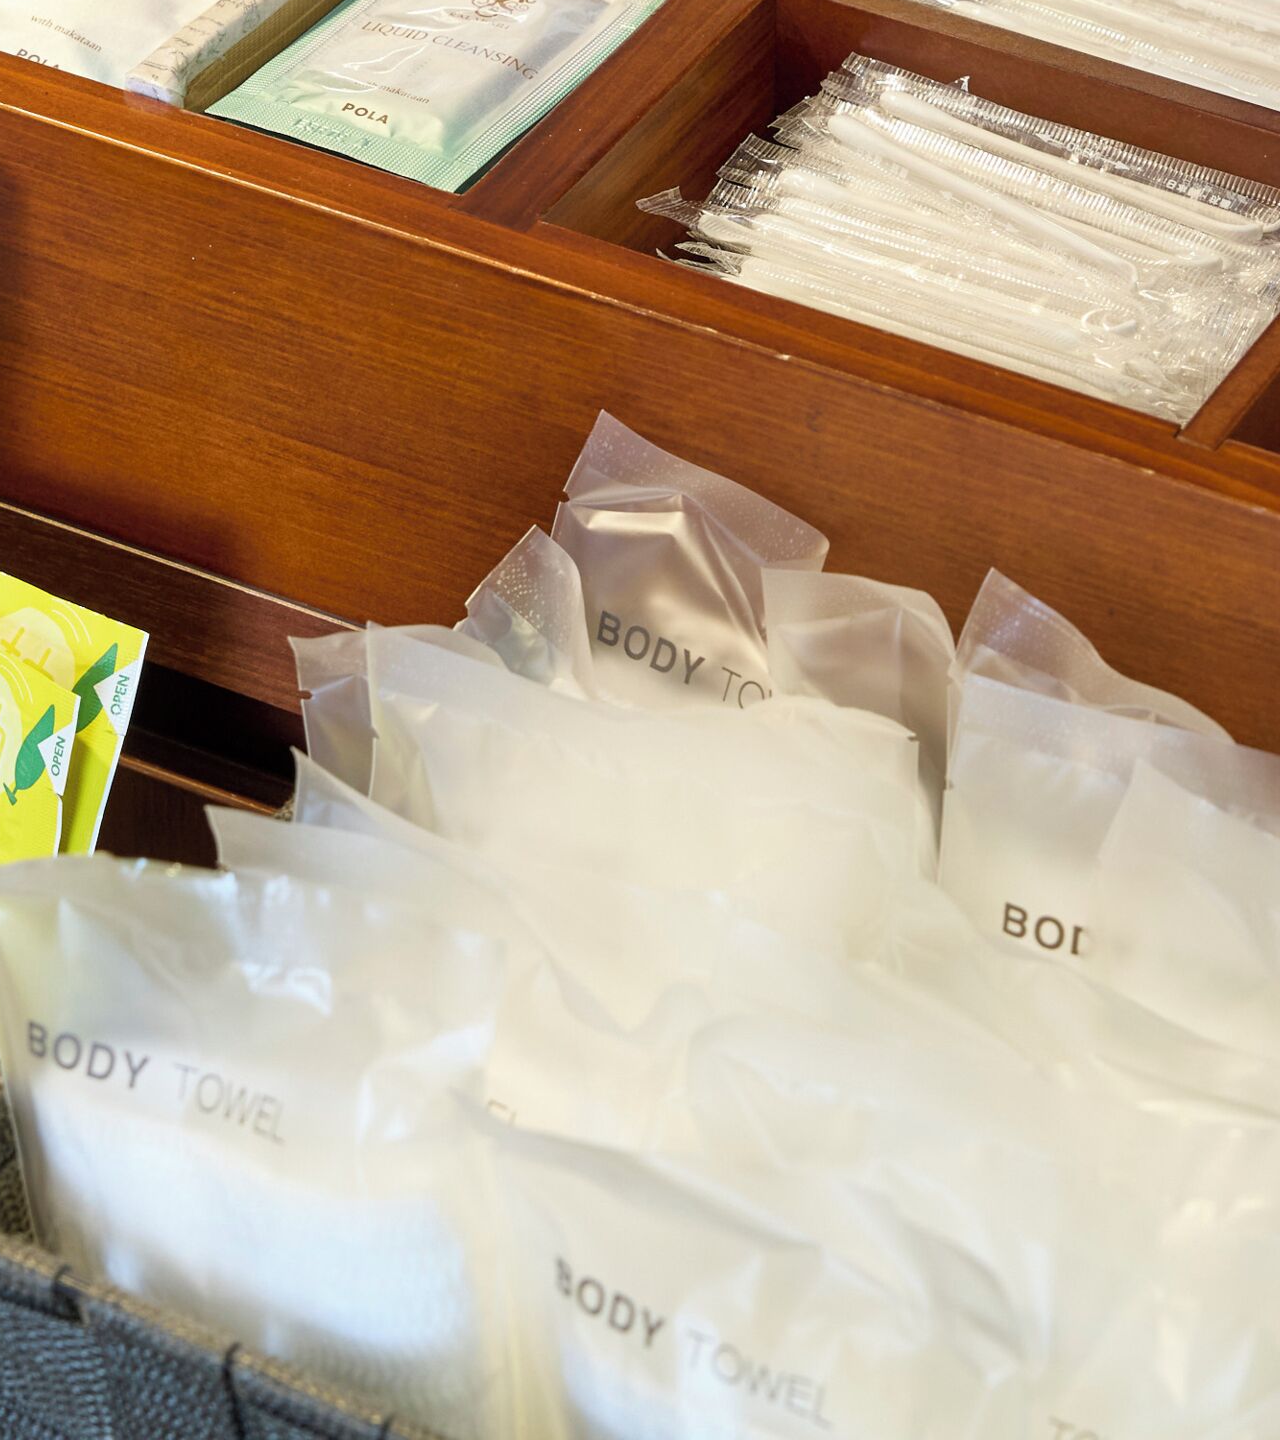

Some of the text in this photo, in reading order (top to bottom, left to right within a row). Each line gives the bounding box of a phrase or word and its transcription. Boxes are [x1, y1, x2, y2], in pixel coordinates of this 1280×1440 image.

[29, 13, 103, 52] with makataan
[360, 19, 540, 82] LIQUID CLEANSING
[341, 101, 390, 126] POLA
[596, 610, 707, 686] BODY
[109, 673, 131, 716] OPEN
[49, 734, 68, 778] OPEN
[27, 1019, 286, 1145] BODY TOWEL
[555, 1257, 837, 1431] BODY TOWEL
